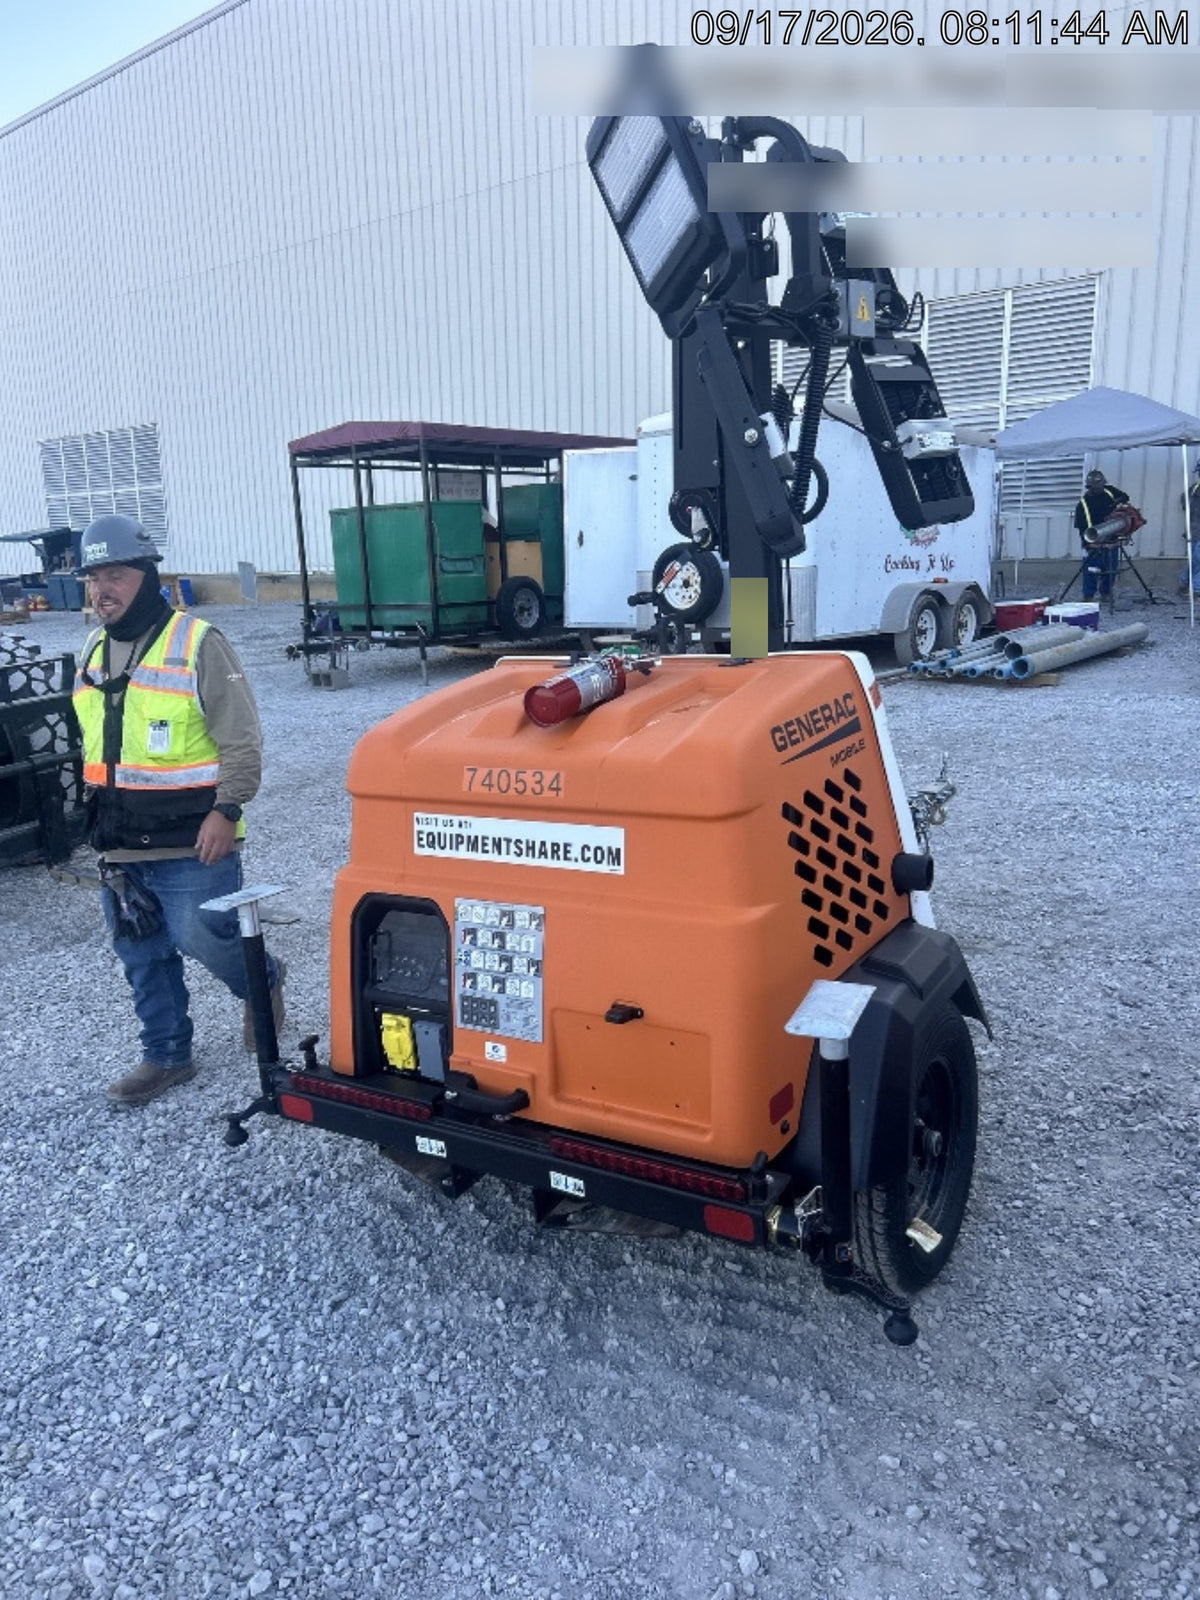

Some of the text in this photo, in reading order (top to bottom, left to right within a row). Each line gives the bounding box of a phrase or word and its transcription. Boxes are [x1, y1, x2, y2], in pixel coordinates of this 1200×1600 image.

[770, 692, 857, 753] GENERAC
[829, 738, 866, 768] MOBILE
[466, 767, 562, 797] 740534
[416, 816, 438, 827] VISIT
[442, 818, 454, 828] US
[416, 829, 622, 867] EQUIPMENTSHARE.COM
